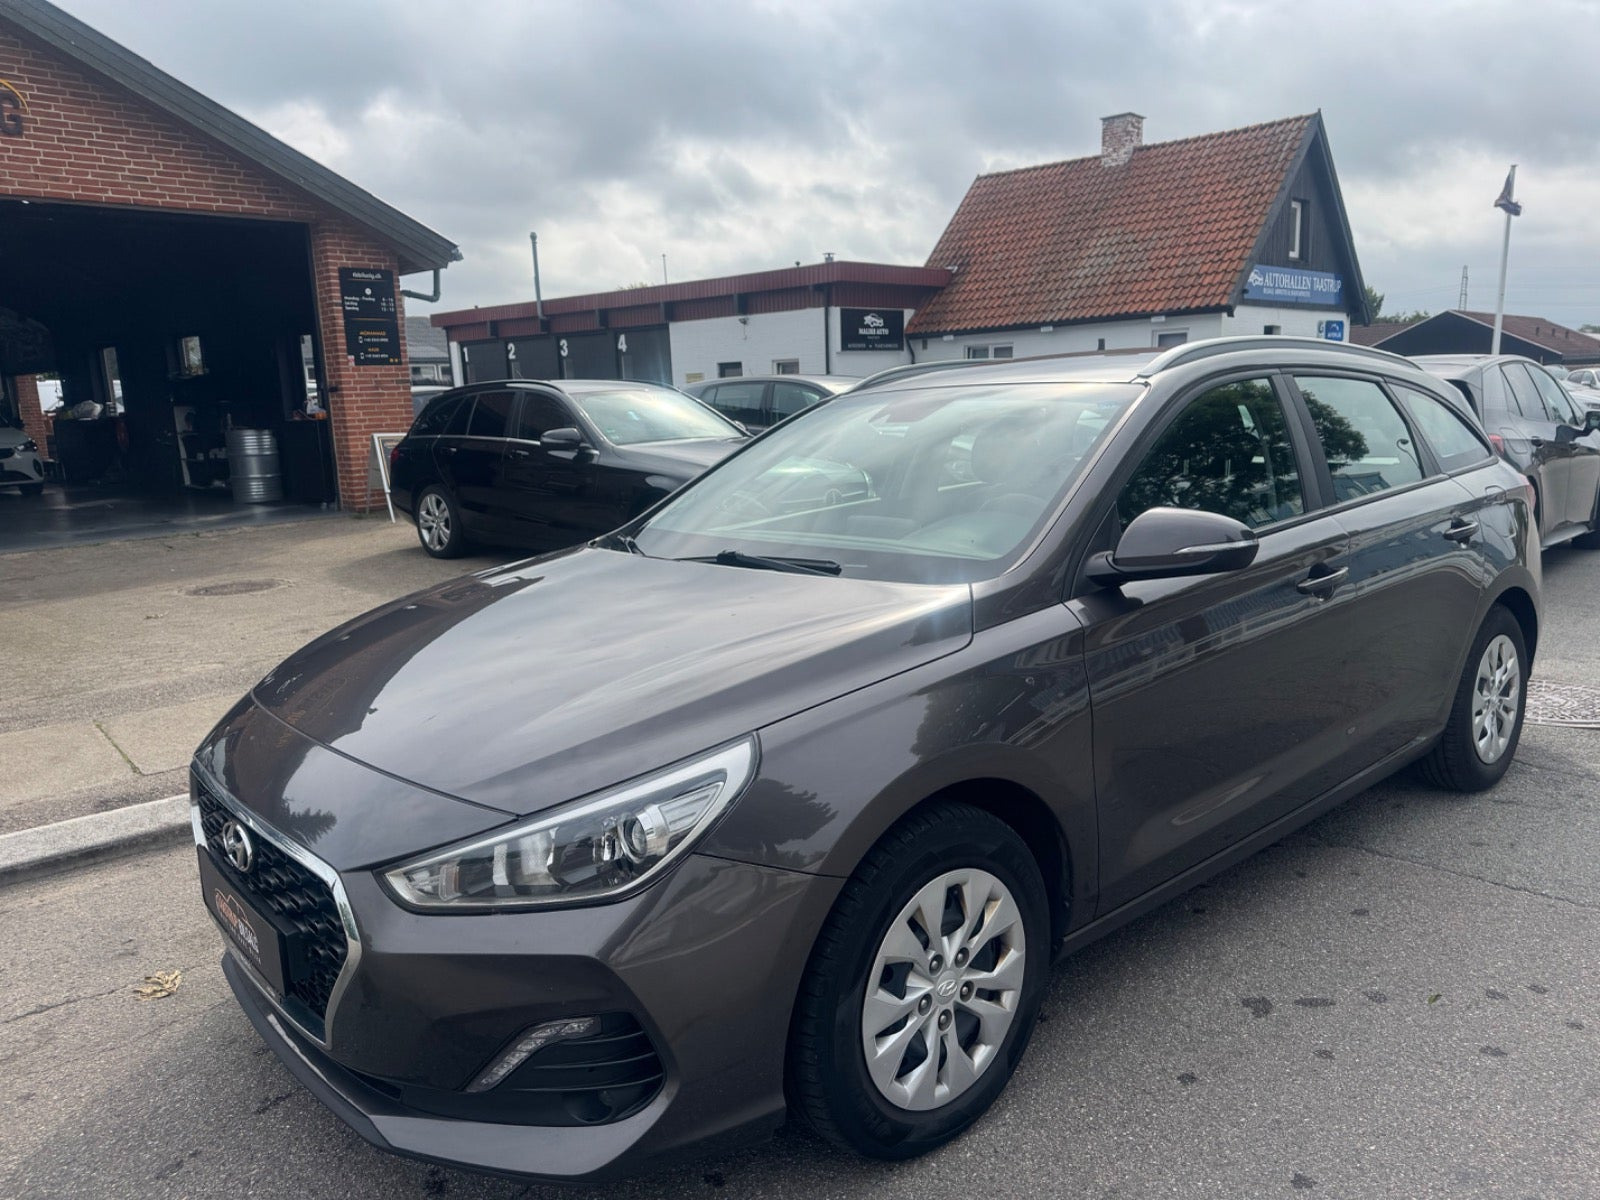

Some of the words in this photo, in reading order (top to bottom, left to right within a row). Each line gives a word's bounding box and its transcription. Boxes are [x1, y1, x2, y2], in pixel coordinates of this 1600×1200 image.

[1263, 272, 1311, 289] AUTOHALLEN
[1313, 277, 1341, 293] TAASTRUP
[507, 343, 516, 360] 2
[559, 339, 569, 357] 3
[617, 334, 628, 353] 4
[463, 347, 469, 362] 1
